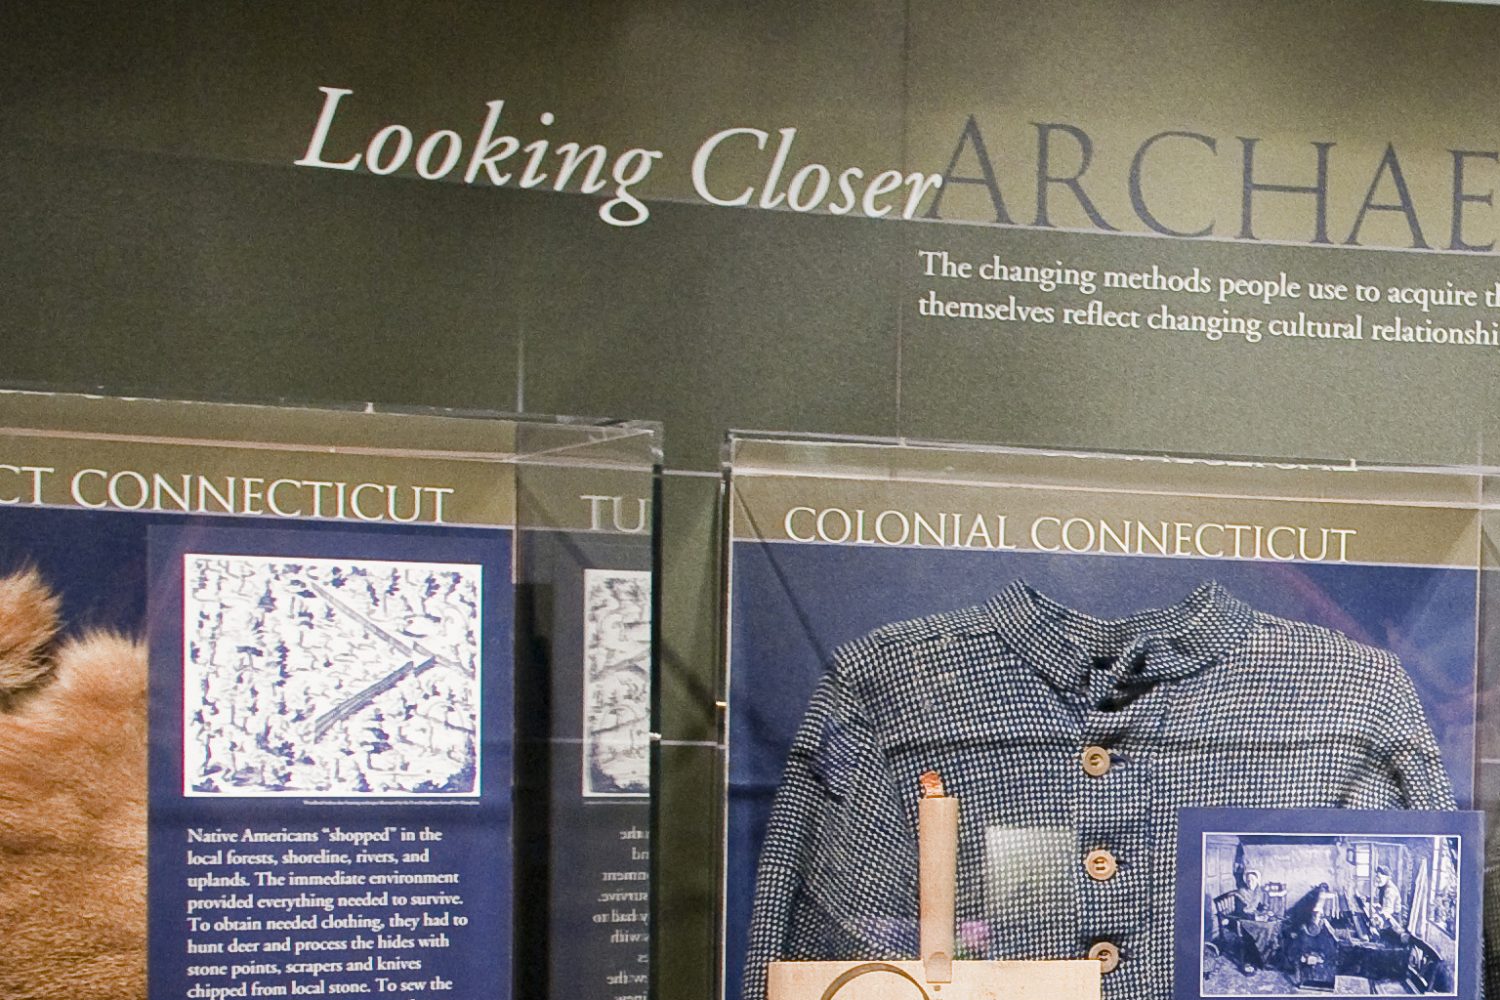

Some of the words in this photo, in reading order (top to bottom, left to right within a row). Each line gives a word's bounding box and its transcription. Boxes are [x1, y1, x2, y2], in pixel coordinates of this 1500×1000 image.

[294, 86, 662, 227] Looking
[691, 126, 944, 220] Closer
[918, 249, 972, 278] The
[979, 254, 1096, 294] changing
[1103, 264, 1211, 293] methods
[1218, 271, 1300, 304] people
[1308, 282, 1347, 300] use
[1355, 283, 1380, 302] to
[1387, 280, 1477, 312] acquire
[918, 290, 1054, 323] themselves
[1063, 299, 1140, 328] reflect
[1147, 304, 1262, 342] changing
[1268, 311, 1363, 339] cultural
[71, 469, 455, 524] CONNECTICUT
[783, 506, 1017, 549] COLONIAL
[1029, 516, 1358, 563] CONNECTICUT
[187, 828, 238, 843] Native
[240, 827, 319, 842] Americans
[321, 826, 397, 845] “shopped”
[400, 827, 415, 841] in
[418, 826, 443, 841] the
[186, 871, 250, 890] uplands.
[253, 871, 286, 886] The
[288, 869, 366, 885] immediate
[368, 870, 459, 884] environment
[186, 981, 247, 1000] chipped
[250, 980, 287, 996] from
[291, 979, 325, 995] local
[328, 983, 371, 994] stone.
[374, 977, 397, 992] To
[399, 981, 427, 991] sew
[429, 975, 452, 990] the
